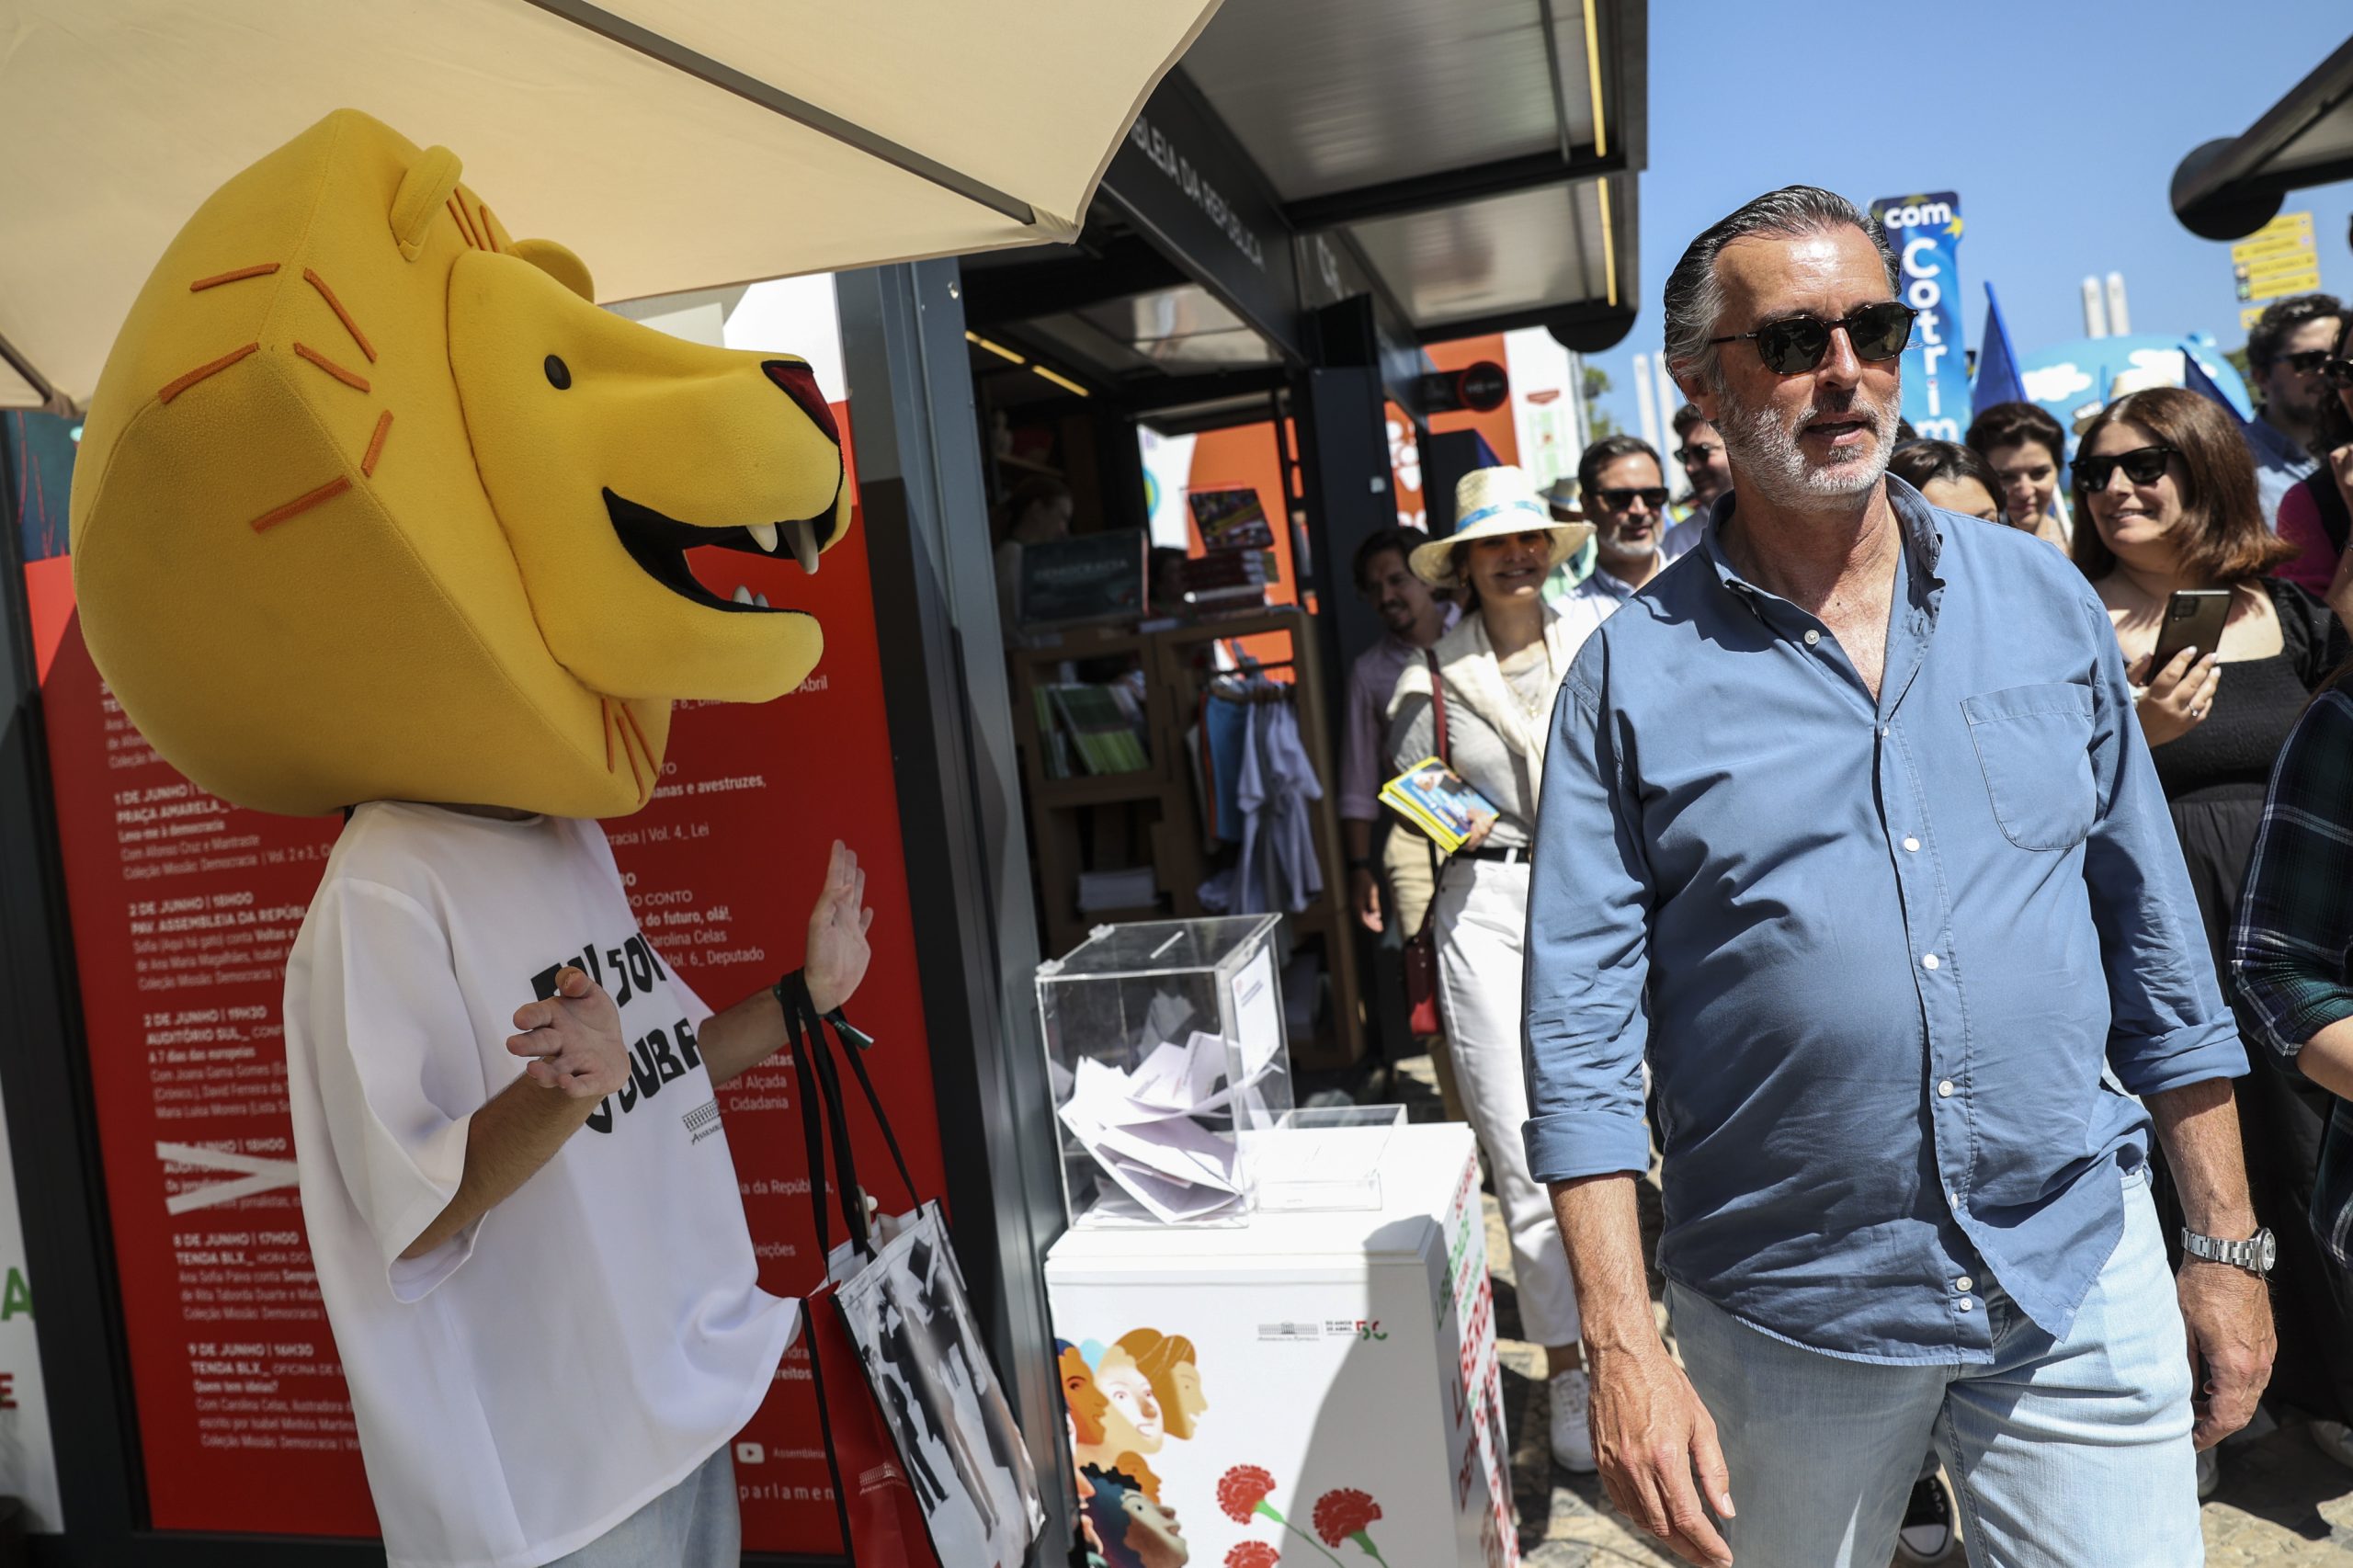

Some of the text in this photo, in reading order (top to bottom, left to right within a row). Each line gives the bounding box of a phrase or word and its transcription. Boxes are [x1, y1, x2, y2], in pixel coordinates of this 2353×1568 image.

[1884, 201, 1952, 230] com
[644, 889, 693, 906] CONTO
[645, 911, 662, 927] do
[663, 909, 705, 926] futuro,
[692, 928, 728, 945] Celas
[706, 946, 766, 967] Deputado
[746, 1073, 788, 1093] Alçada
[730, 1095, 790, 1112] Cidadania
[753, 1179, 769, 1195] da
